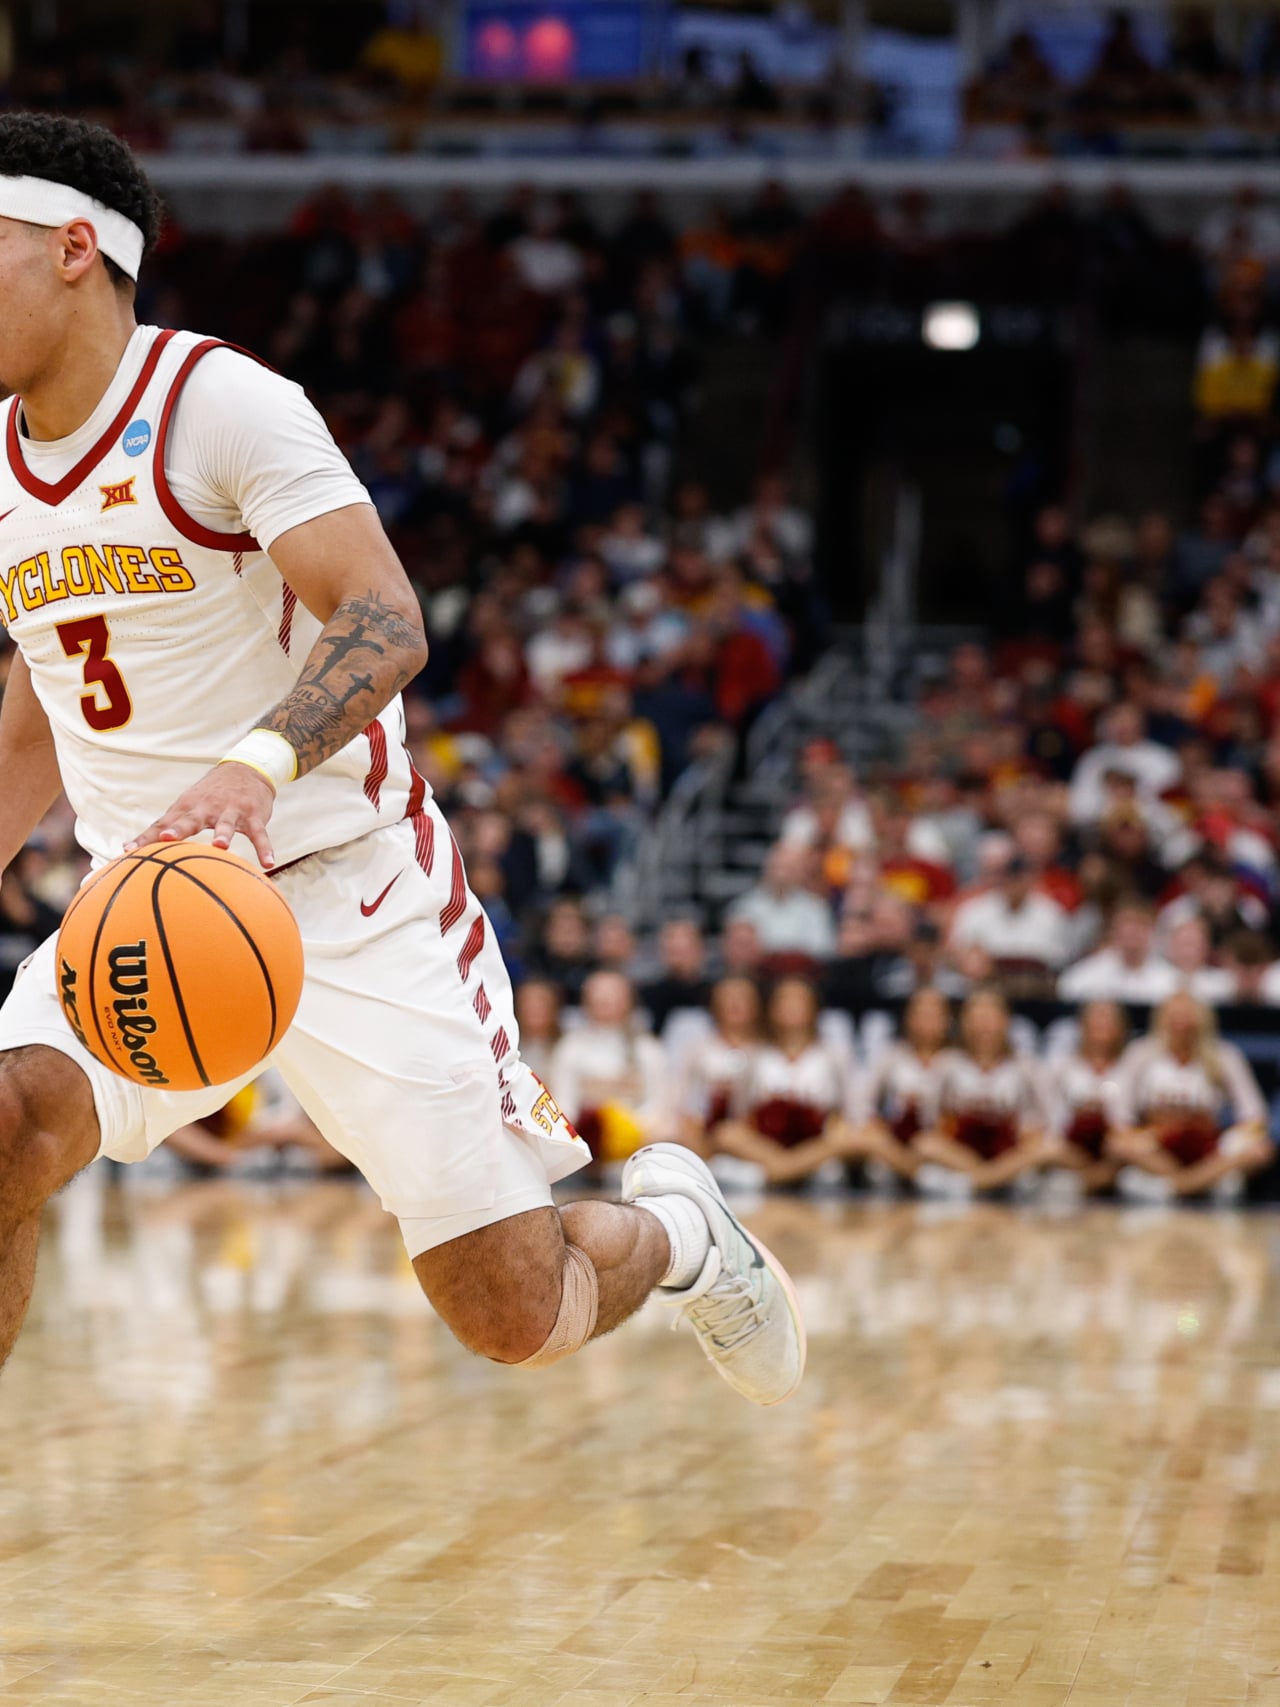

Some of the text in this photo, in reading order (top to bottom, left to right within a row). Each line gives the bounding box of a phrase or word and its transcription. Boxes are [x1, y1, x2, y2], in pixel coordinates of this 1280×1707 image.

[53, 612, 135, 734] 3
[104, 1006, 114, 1029] EVO
[108, 938, 170, 1085] Wilson
